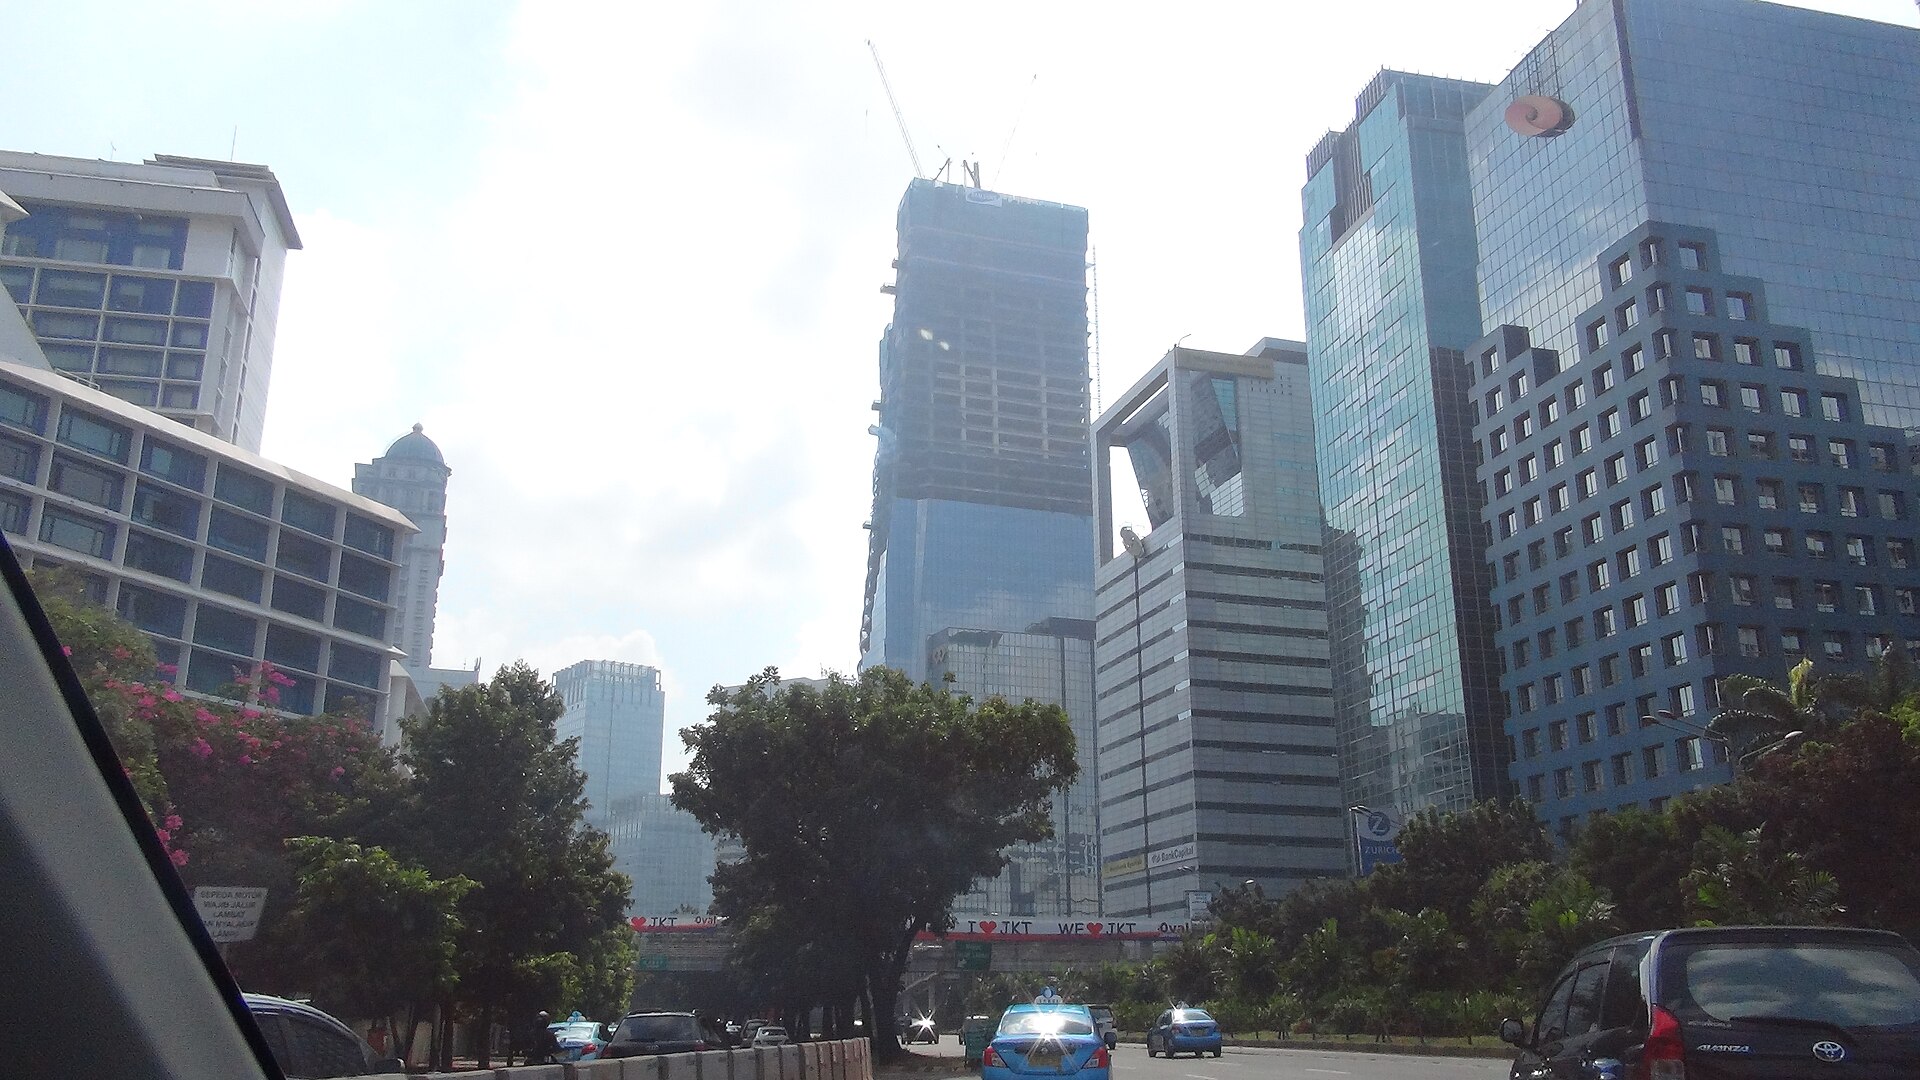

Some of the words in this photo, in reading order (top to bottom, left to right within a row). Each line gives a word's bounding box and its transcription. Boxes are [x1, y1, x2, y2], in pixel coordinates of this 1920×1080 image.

[1364, 846, 1397, 855] ZURIC
[648, 916, 678, 928] JKT
[694, 916, 717, 925] Oval
[967, 920, 977, 933] I
[1000, 921, 1033, 935] JKT
[1058, 922, 1084, 935] WE
[1106, 922, 1137, 935] JKT
[1159, 922, 1190, 933] Oval
[1696, 1044, 1750, 1053] AVANZA
